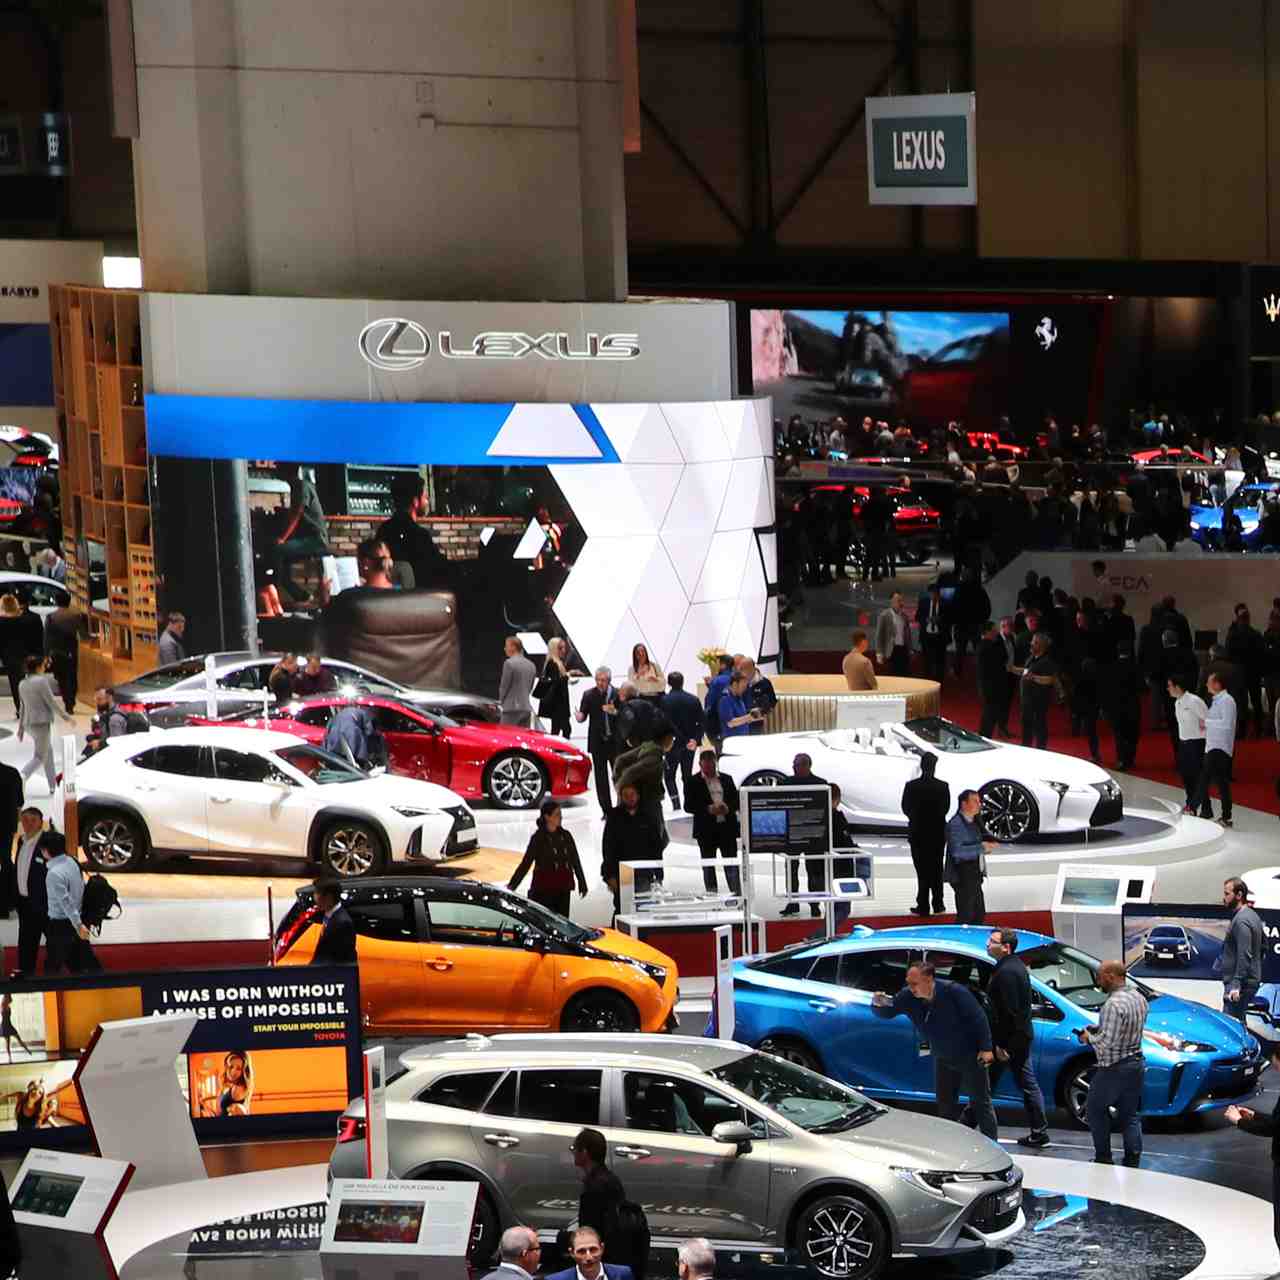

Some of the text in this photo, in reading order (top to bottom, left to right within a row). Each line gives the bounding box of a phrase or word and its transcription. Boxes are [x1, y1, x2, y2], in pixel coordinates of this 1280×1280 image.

[893, 130, 945, 170] LEXUS
[438, 331, 640, 360] LEXUS
[162, 984, 345, 1003] I WAS BORN WITHOUT
[222, 1005, 243, 1018] OF
[248, 1002, 349, 1018] IMPOSSIBLE.
[253, 1021, 346, 1033] START YOUR IMPOSSIBLE
